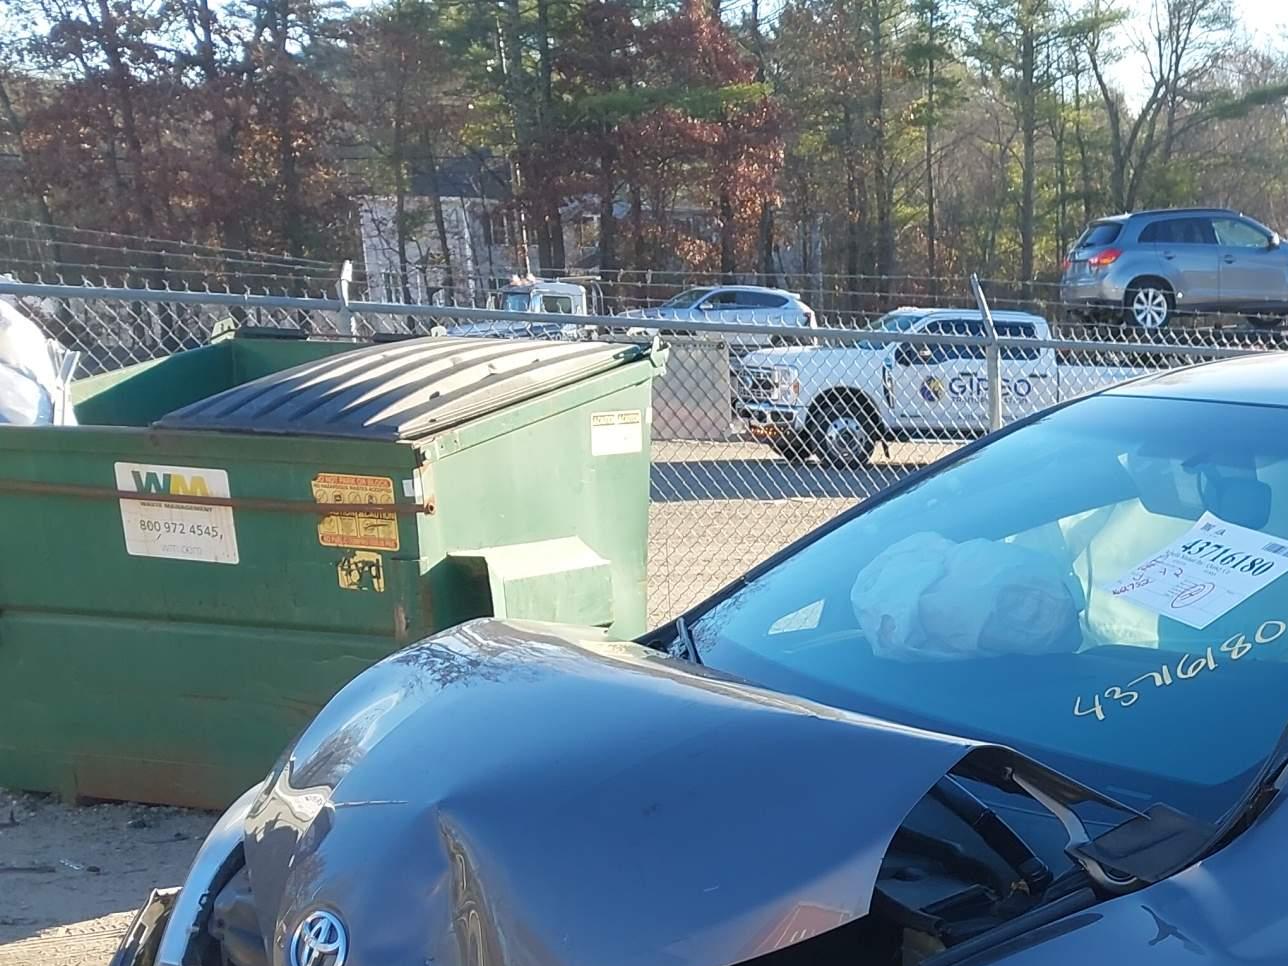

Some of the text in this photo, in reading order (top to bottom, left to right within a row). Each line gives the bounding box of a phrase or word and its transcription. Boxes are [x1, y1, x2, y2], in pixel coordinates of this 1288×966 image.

[131, 470, 210, 498] WM
[163, 503, 213, 513] MANAGEMENT
[140, 519, 161, 532] 800
[163, 522, 186, 535] 972
[1181, 538, 1275, 577] 43716180
[1073, 620, 1287, 721] 43716180
